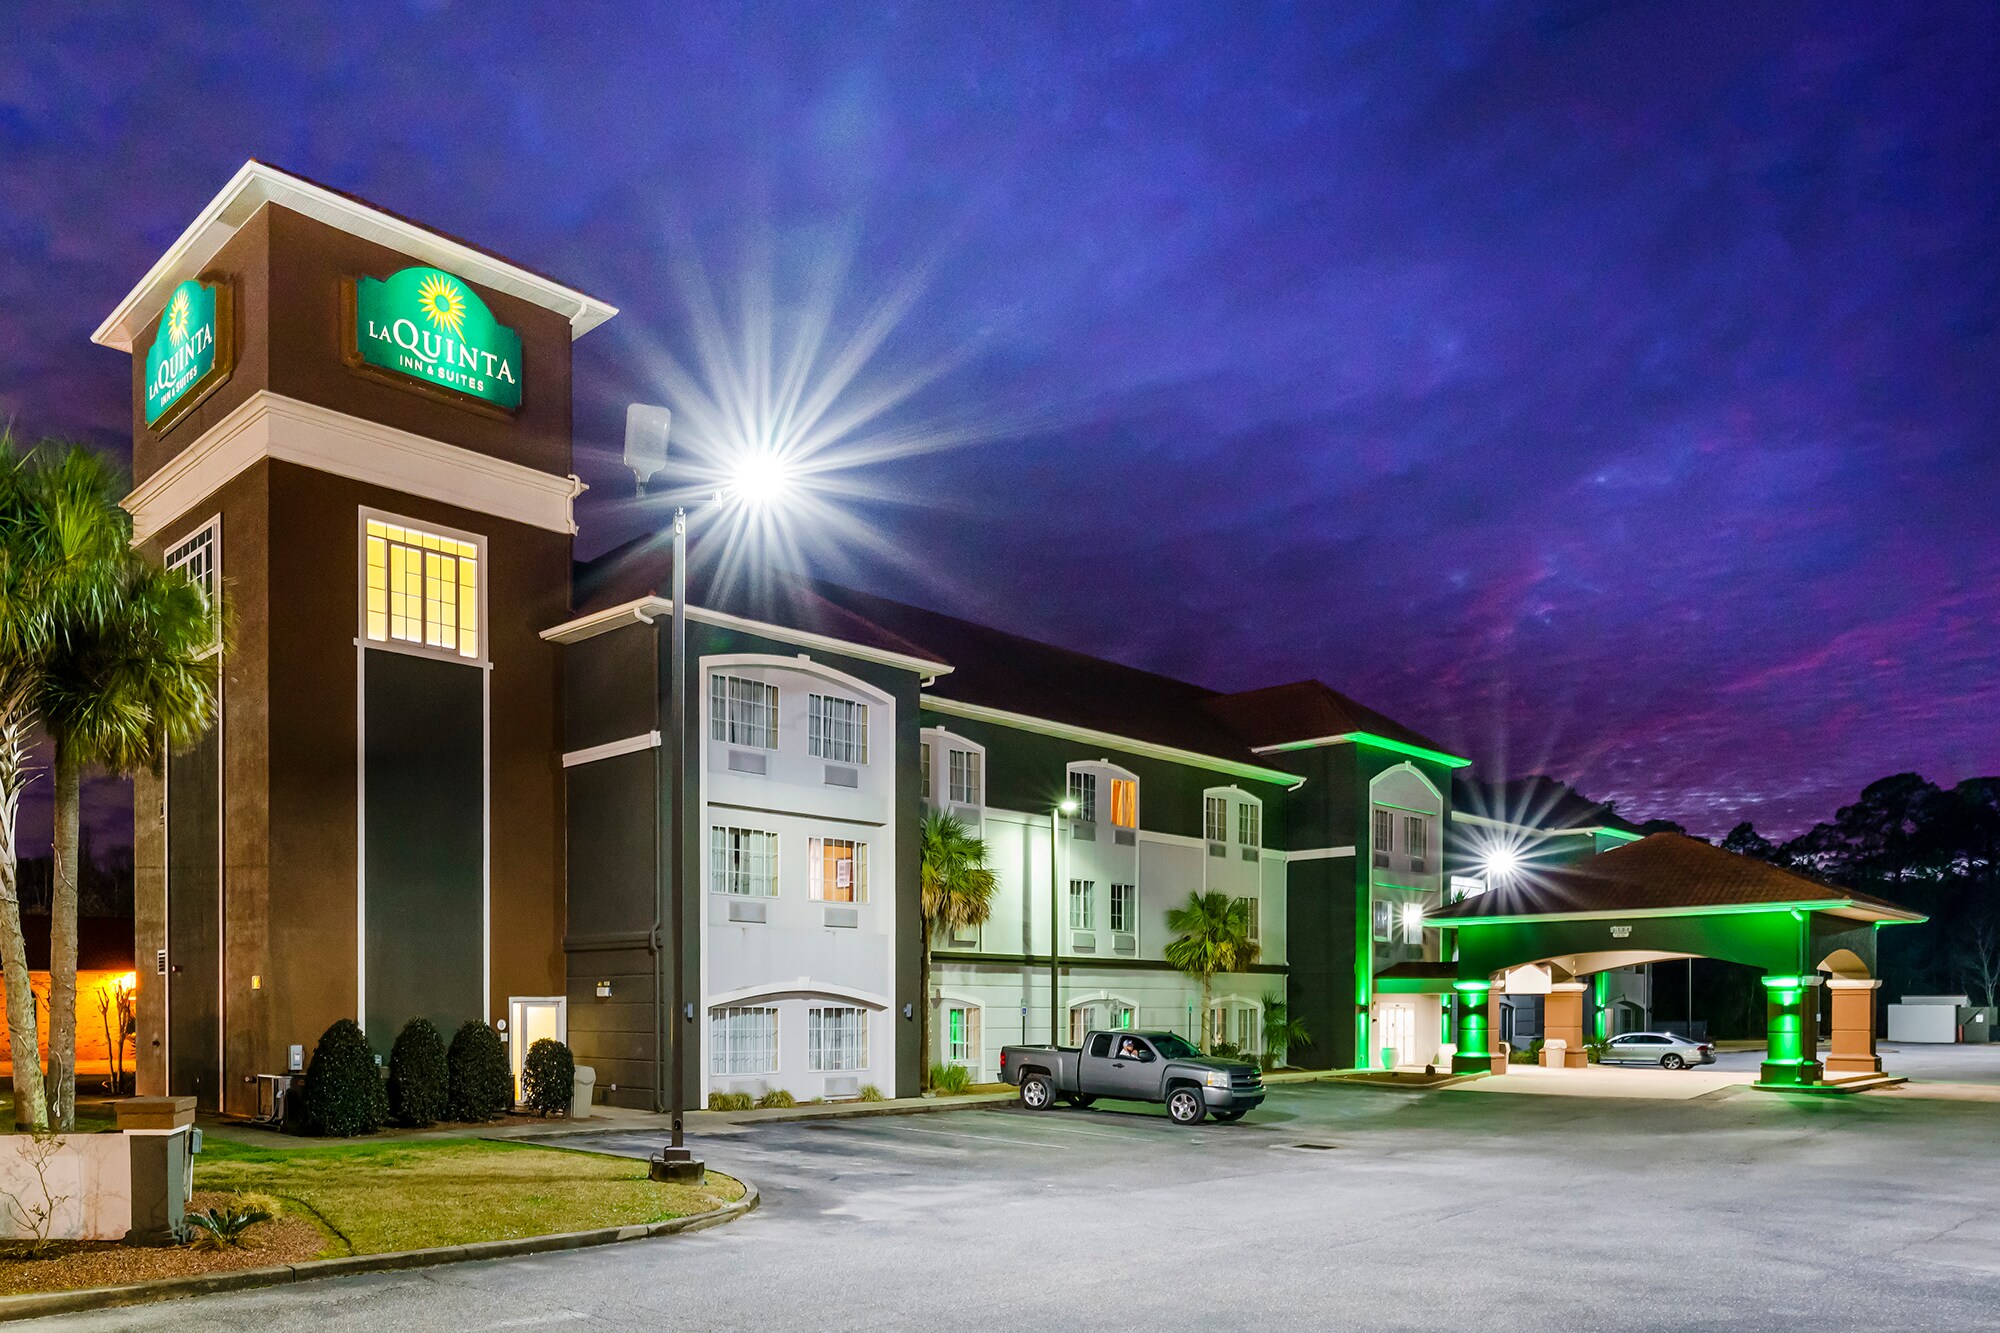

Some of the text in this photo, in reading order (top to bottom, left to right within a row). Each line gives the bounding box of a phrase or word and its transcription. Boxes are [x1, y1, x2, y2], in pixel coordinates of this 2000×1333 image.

[149, 323, 212, 400] LA QUINTA
[368, 319, 515, 384] LA QUINTA
[400, 354, 484, 391] INN & SUITES
[160, 392, 171, 407] INN
[176, 365, 197, 391] SUITES
